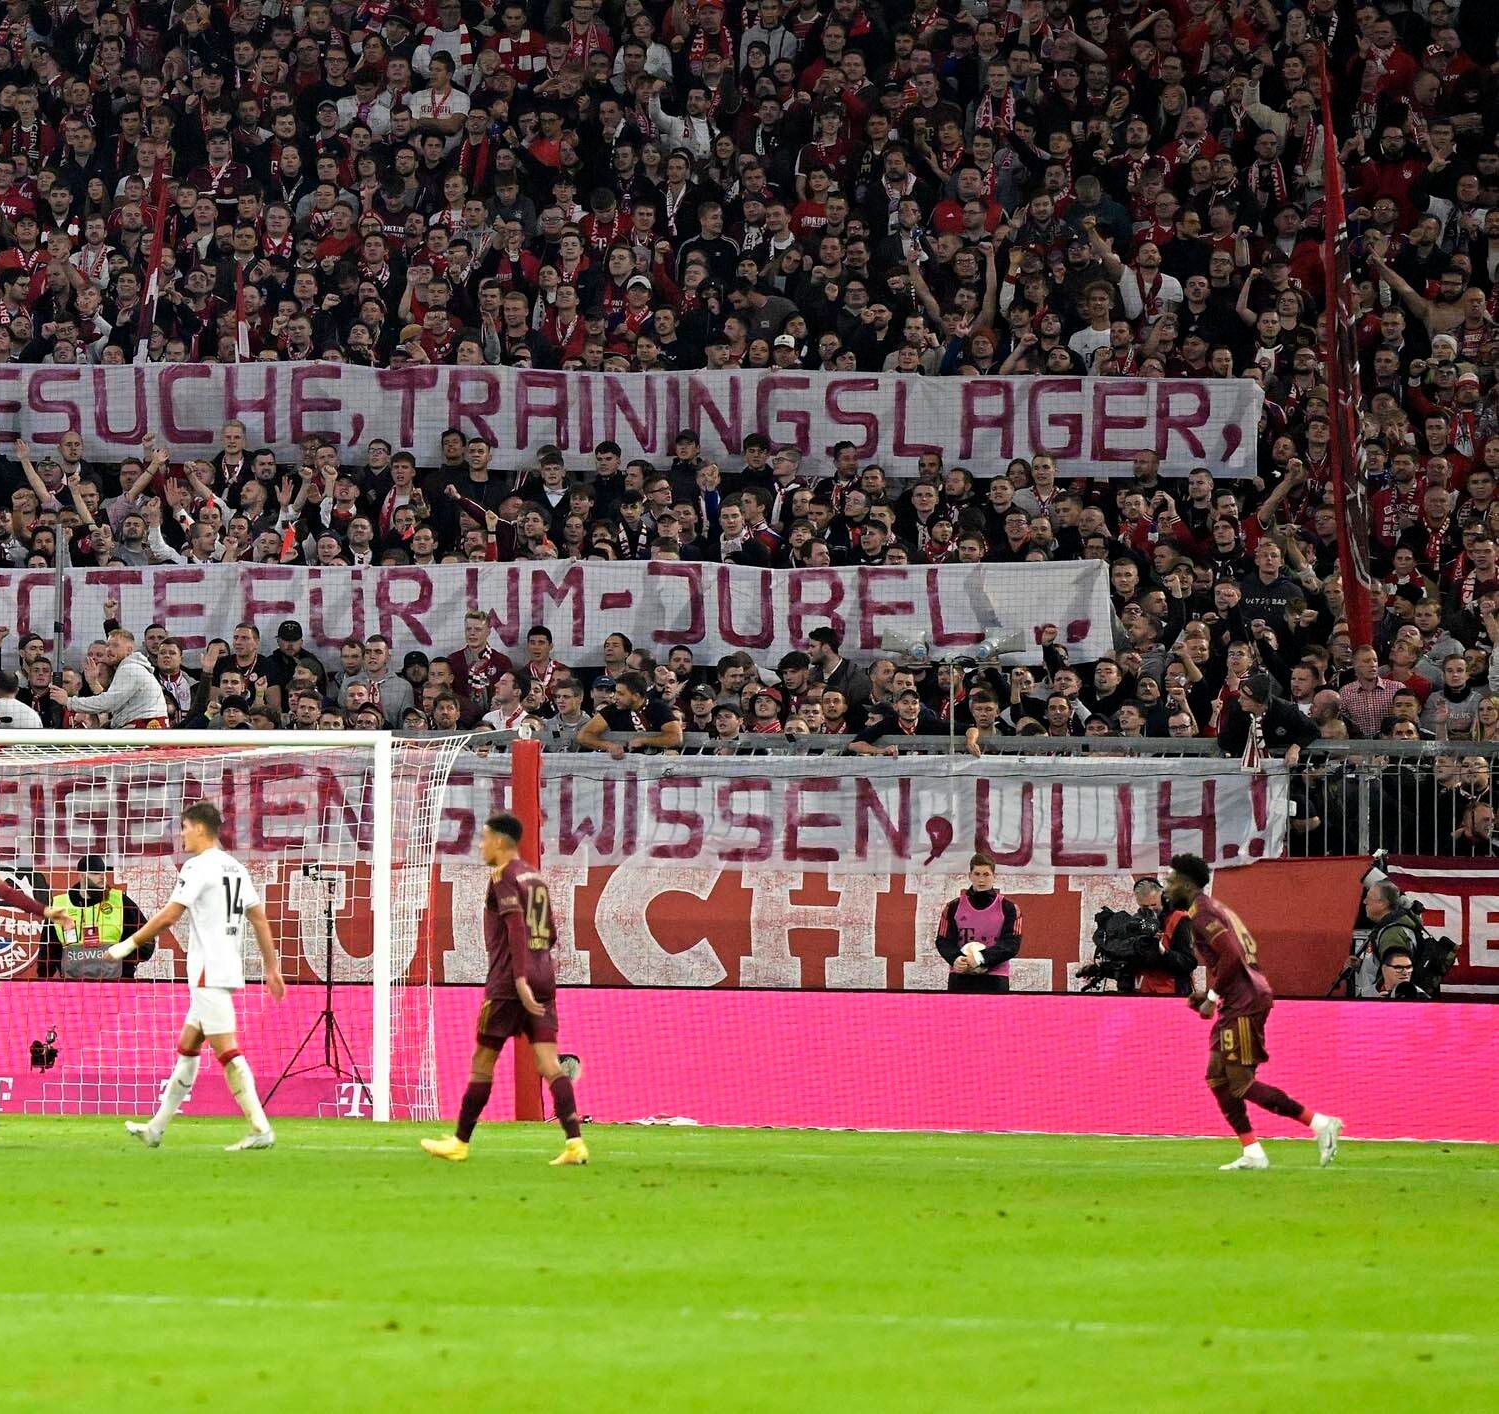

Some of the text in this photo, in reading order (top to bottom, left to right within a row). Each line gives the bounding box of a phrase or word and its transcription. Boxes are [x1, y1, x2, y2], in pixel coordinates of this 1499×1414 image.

[377, 365, 1242, 464] TRAININGSLAGER,
[238, 567, 434, 650] FÜR
[222, 875, 244, 924] 14
[526, 885, 550, 938] 42
[67, 949, 105, 961] stewa
